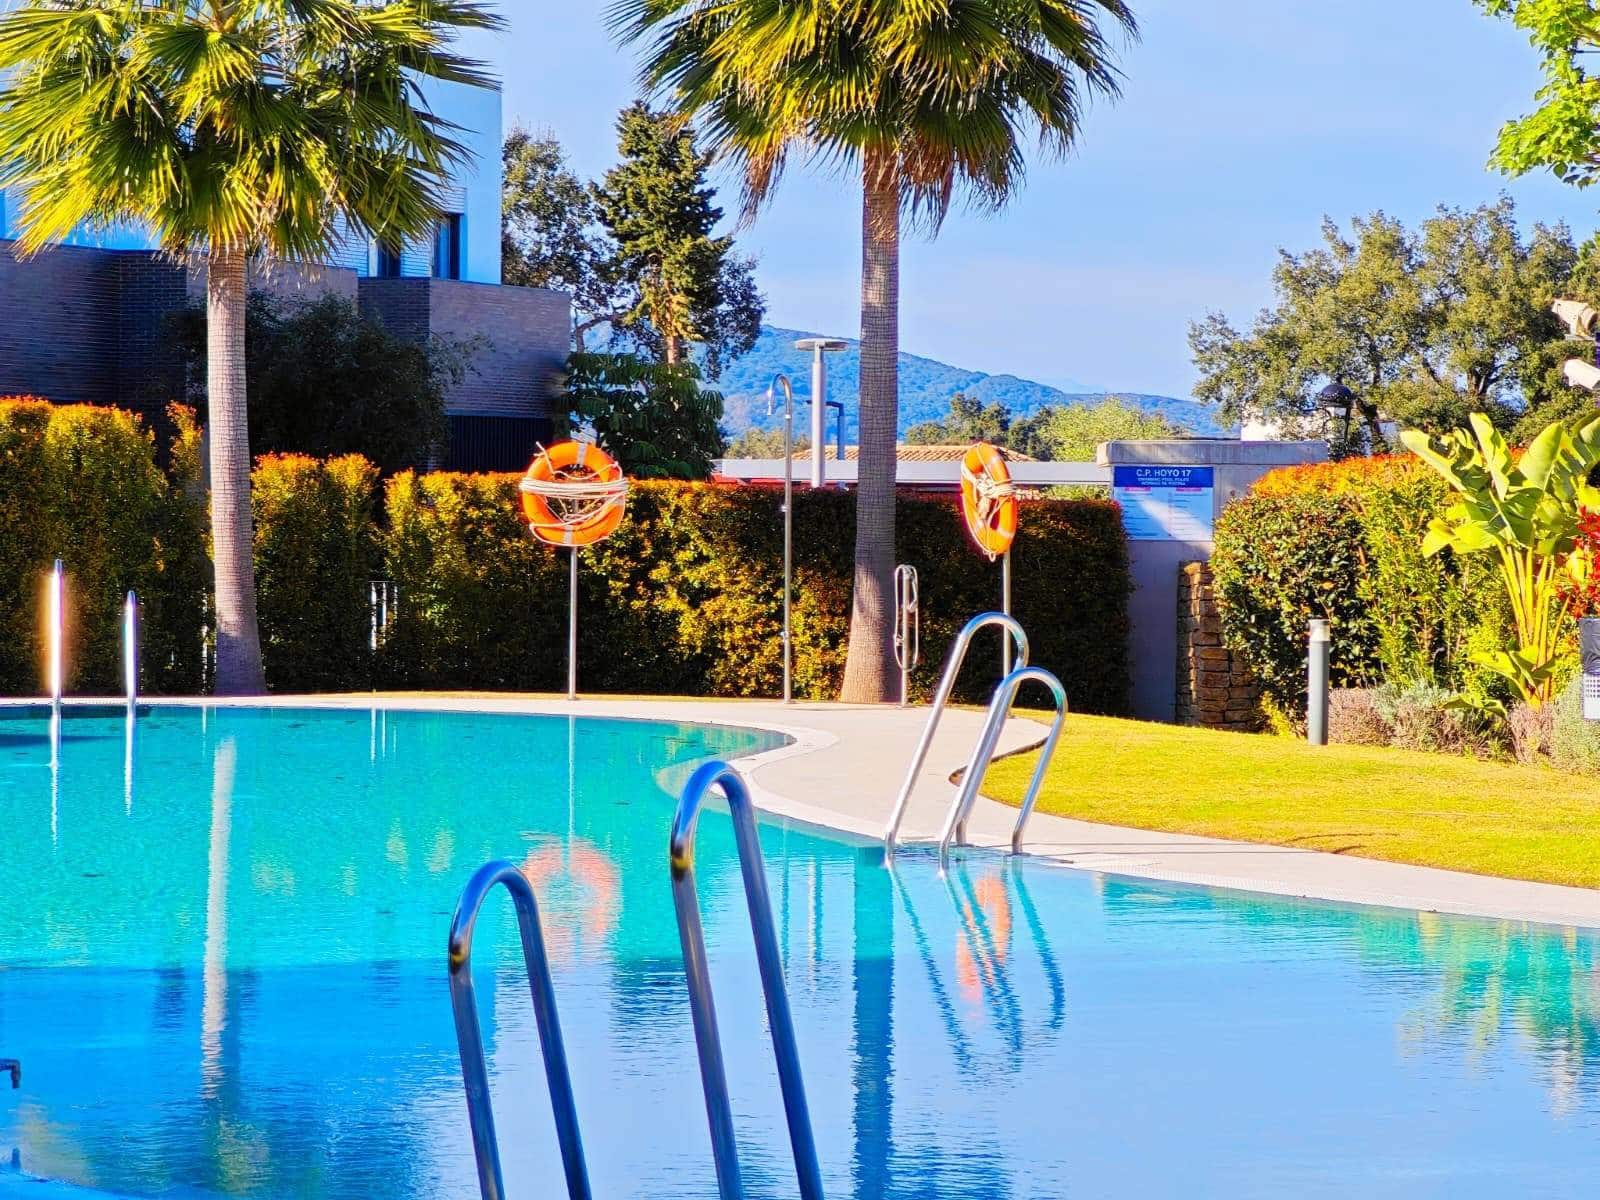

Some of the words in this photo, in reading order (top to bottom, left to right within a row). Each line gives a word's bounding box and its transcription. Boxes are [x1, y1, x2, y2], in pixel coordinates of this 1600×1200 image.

[1136, 469, 1152, 477] C.P.
[1154, 469, 1180, 477] HOYO
[1181, 469, 1192, 477] 17
